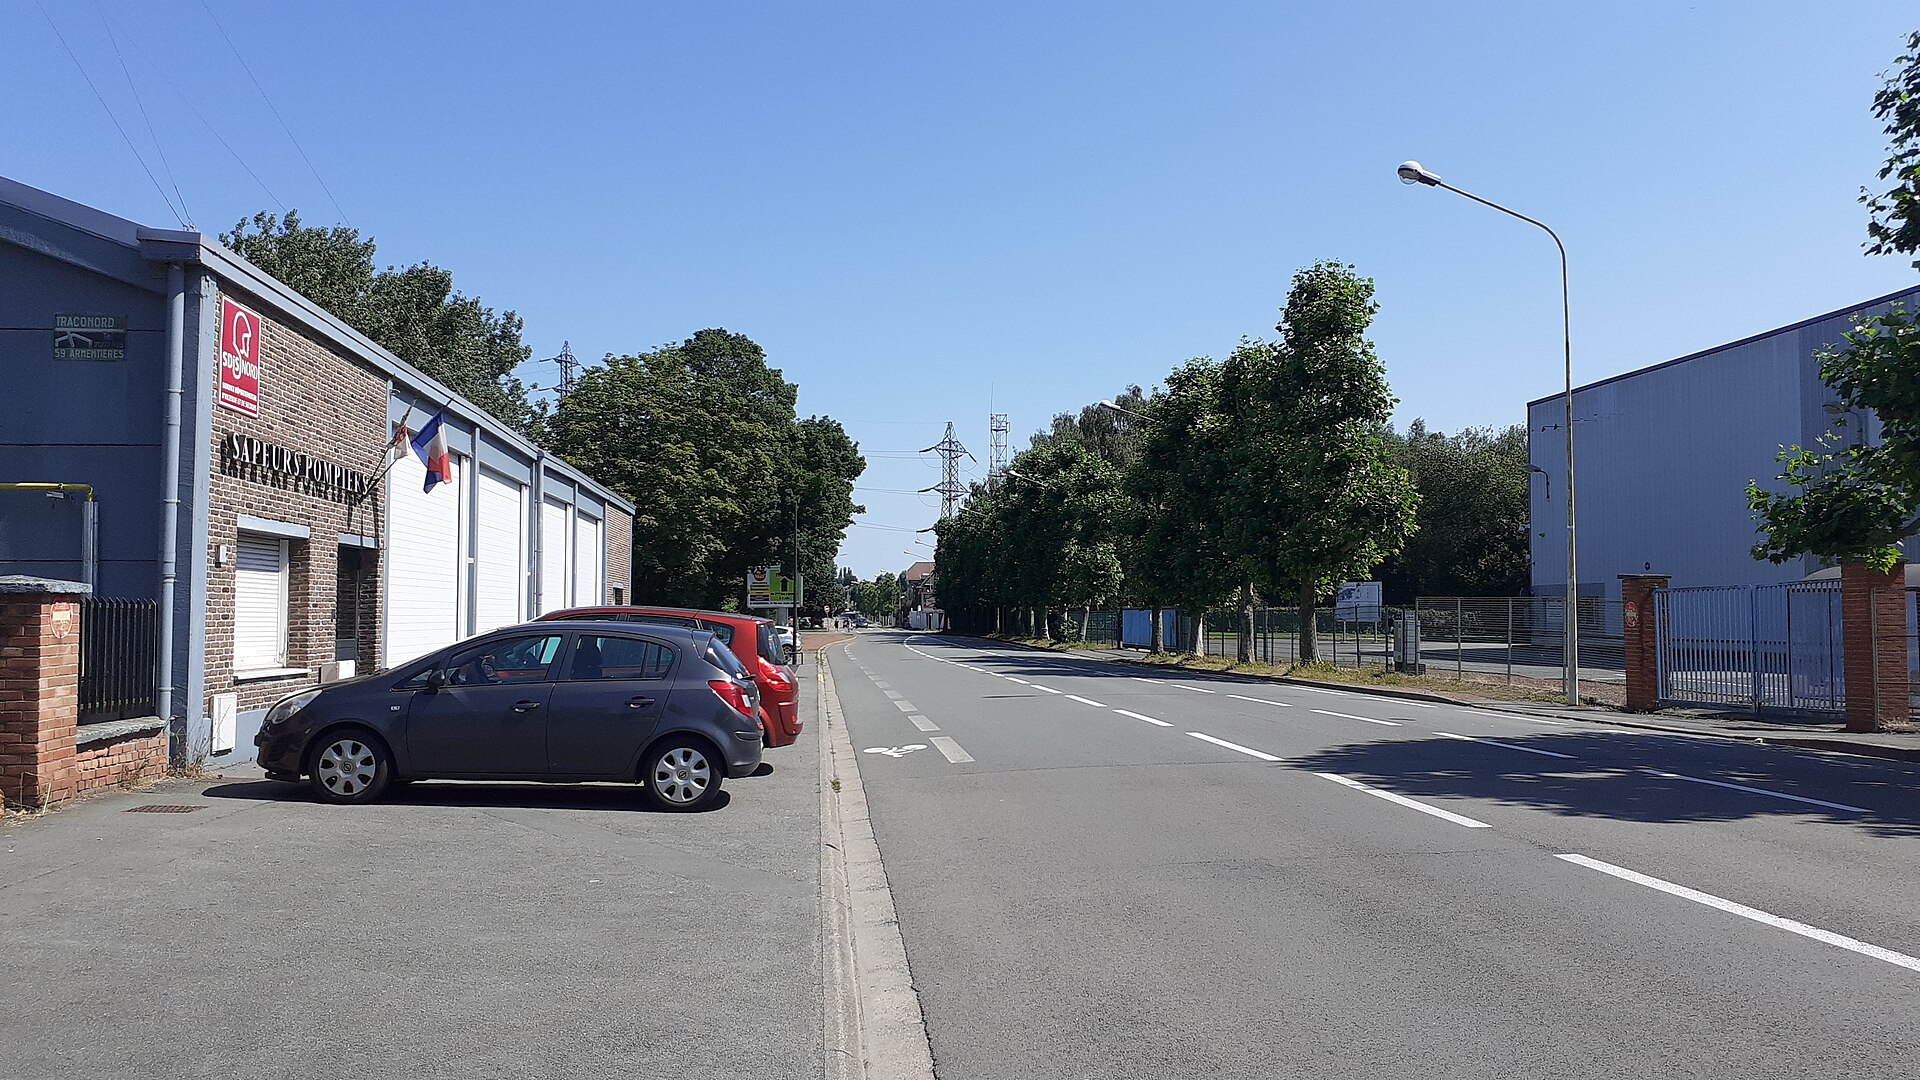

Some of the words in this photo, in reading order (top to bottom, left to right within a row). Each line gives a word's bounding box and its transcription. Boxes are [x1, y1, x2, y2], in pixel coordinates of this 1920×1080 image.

[56, 316, 115, 328] TRACONORD
[54, 348, 66, 358] 59
[69, 348, 124, 359] ARMENTIERES
[241, 359, 258, 381] NORD
[232, 432, 300, 477] SAPEURS
[305, 454, 369, 495] POMPIERS
